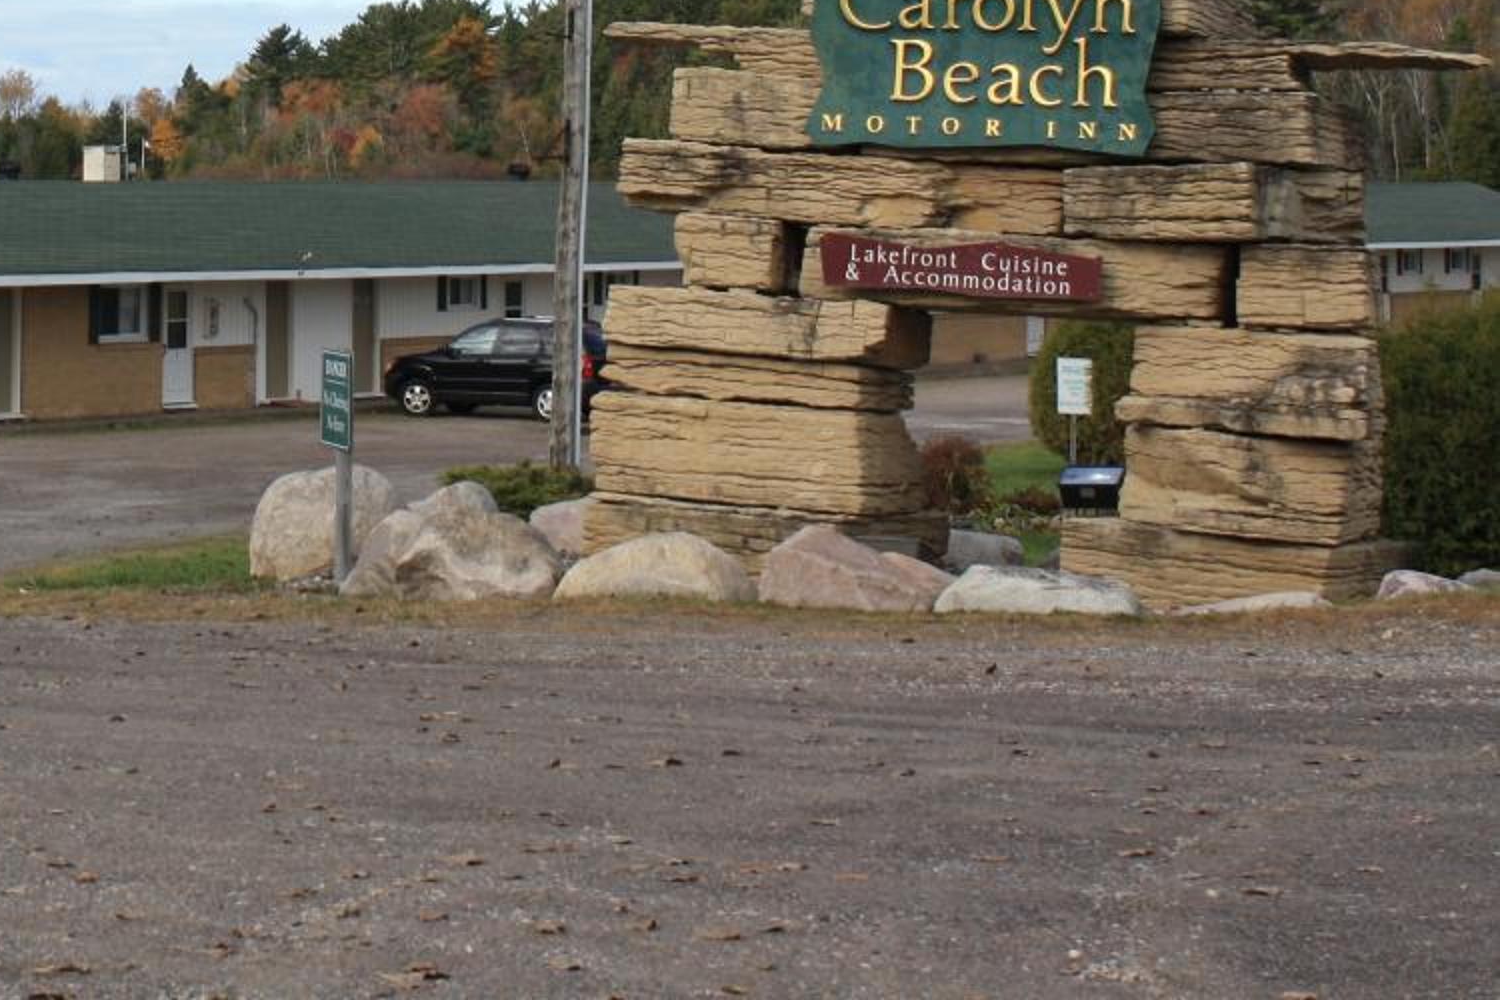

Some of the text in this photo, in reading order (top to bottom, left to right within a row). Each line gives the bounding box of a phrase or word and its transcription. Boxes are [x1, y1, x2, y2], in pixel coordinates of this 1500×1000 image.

[889, 37, 1118, 108] Beach
[821, 113, 1138, 141] MOTOR INN
[850, 243, 1069, 276] Lakefront Cuisine
[845, 263, 1072, 296] & Accommodation
